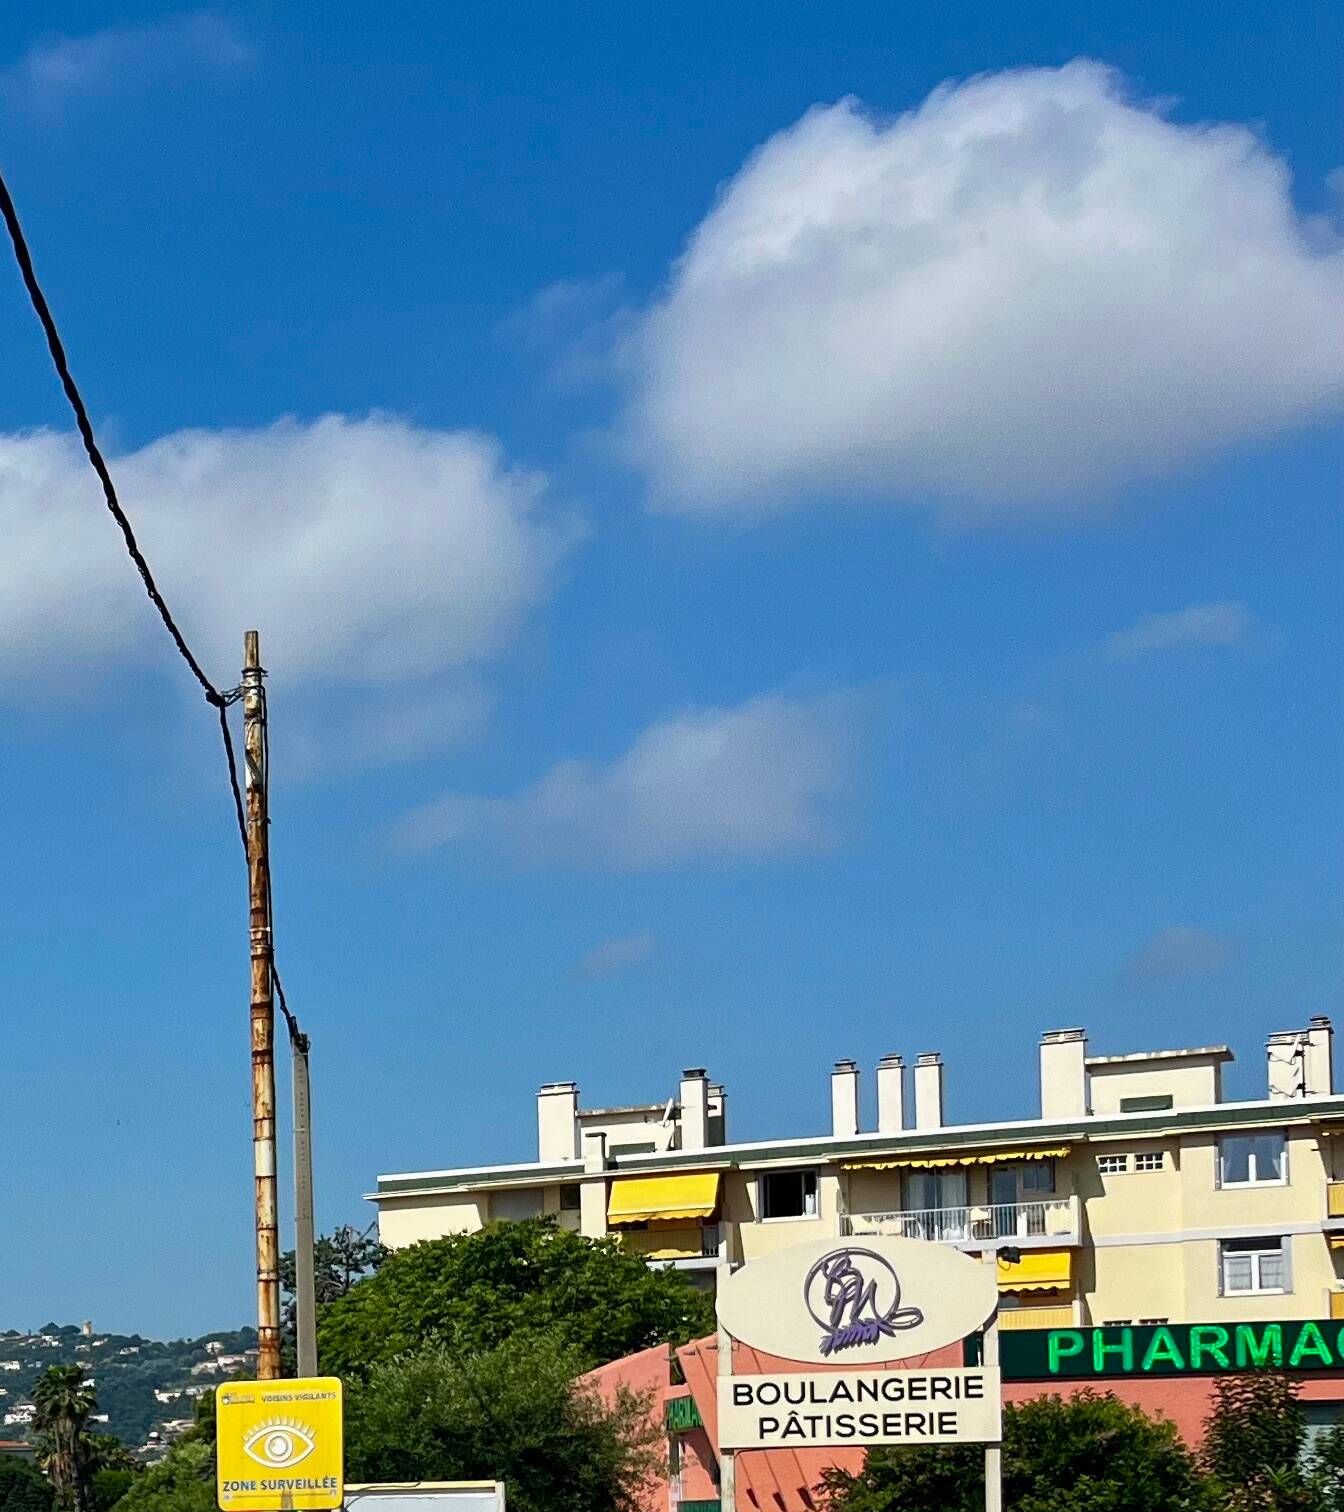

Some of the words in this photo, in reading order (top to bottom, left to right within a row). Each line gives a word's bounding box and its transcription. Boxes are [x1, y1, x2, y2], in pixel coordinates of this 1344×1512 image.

[1047, 1322, 1344, 1374] PHARMA
[733, 1375, 984, 1406] BOULANGERIE
[759, 1410, 958, 1440] PÂTISSERIE
[223, 1480, 257, 1492] ZONE
[260, 1475, 337, 1490] SURVEILLÉE
